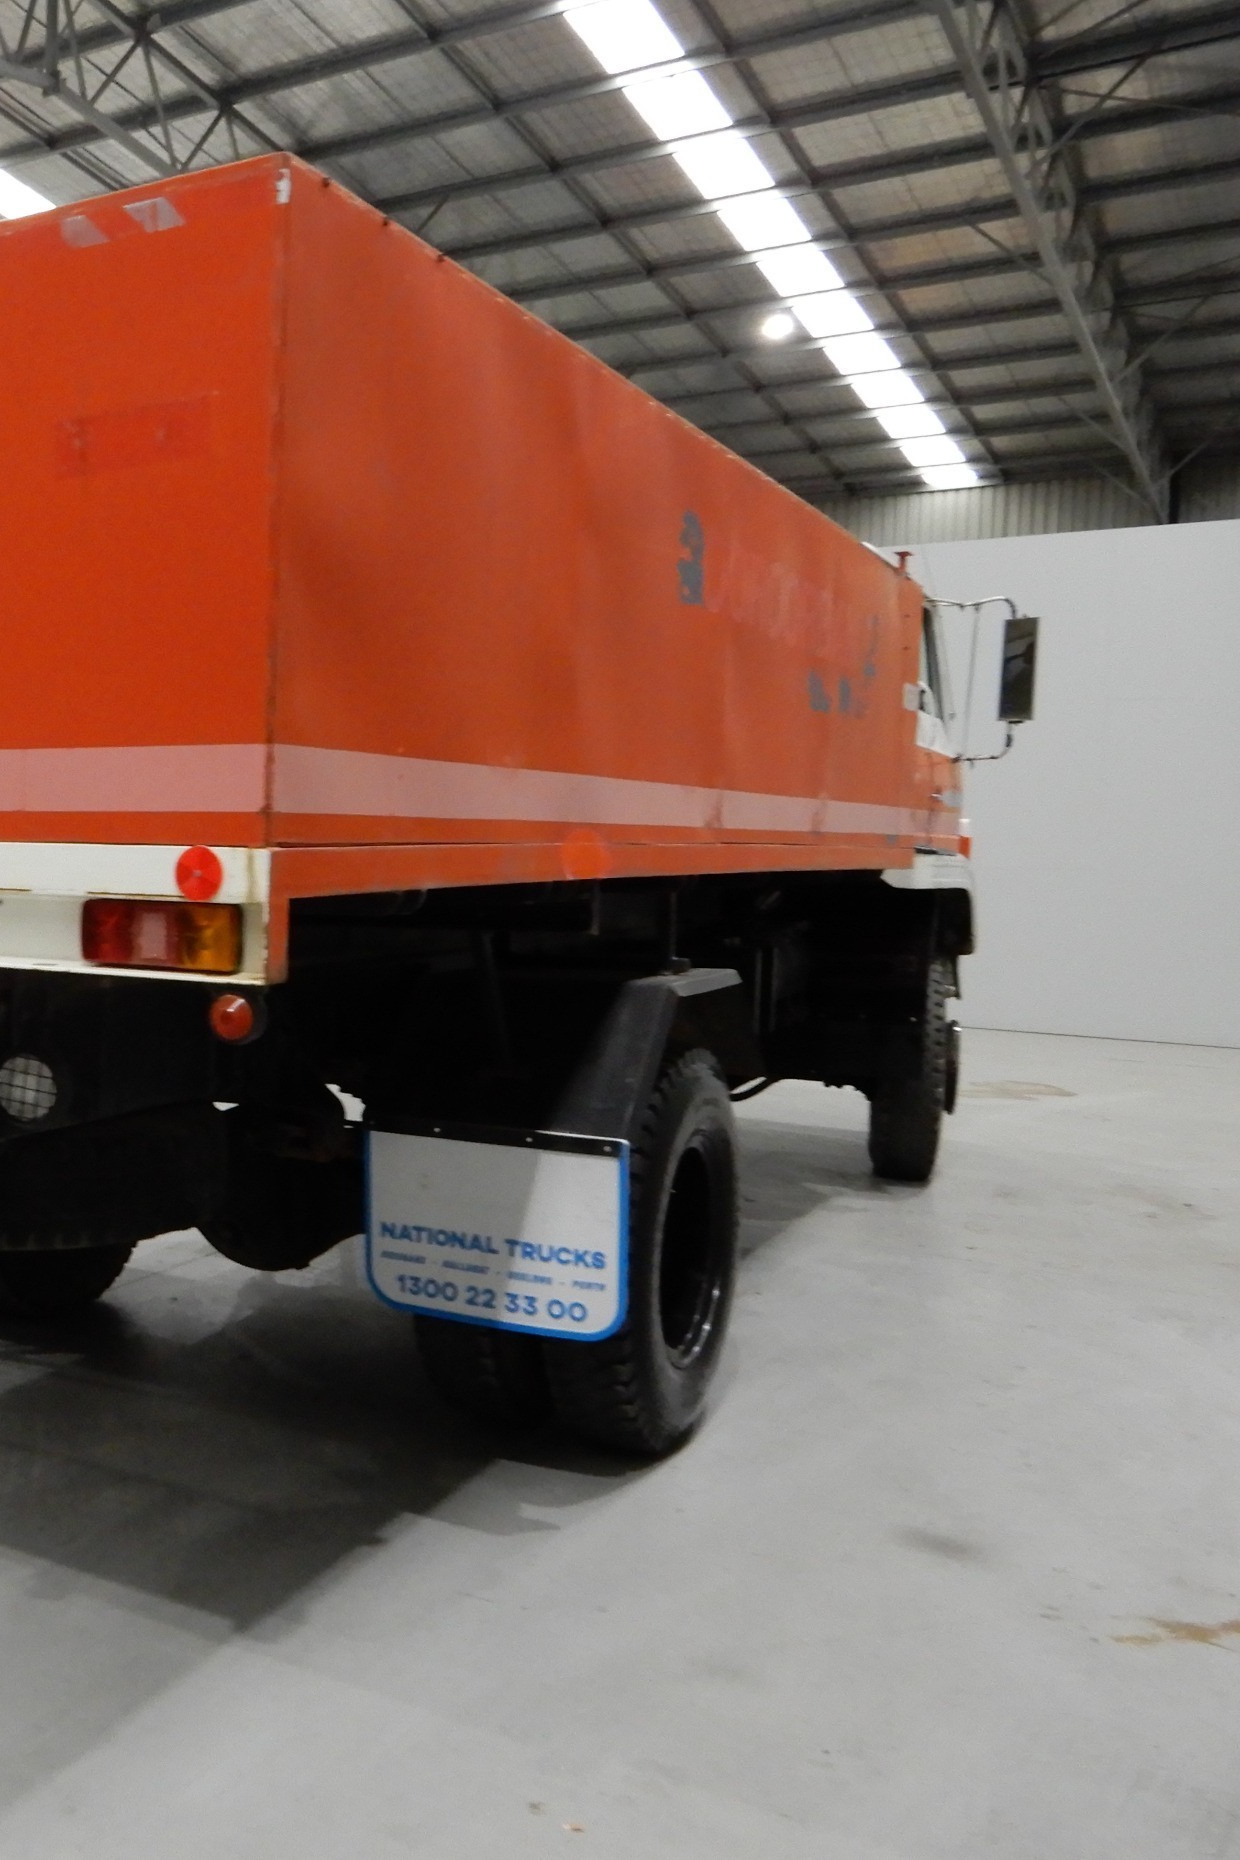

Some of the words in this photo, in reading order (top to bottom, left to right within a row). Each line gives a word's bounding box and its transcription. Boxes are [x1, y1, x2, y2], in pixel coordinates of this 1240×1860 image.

[380, 1221, 499, 1254] NATIONAL
[505, 1238, 606, 1270] TRUCKS
[397, 1274, 459, 1302] 1300
[465, 1285, 497, 1309] 22
[504, 1292, 538, 1316] 33
[547, 1299, 587, 1322] 00
